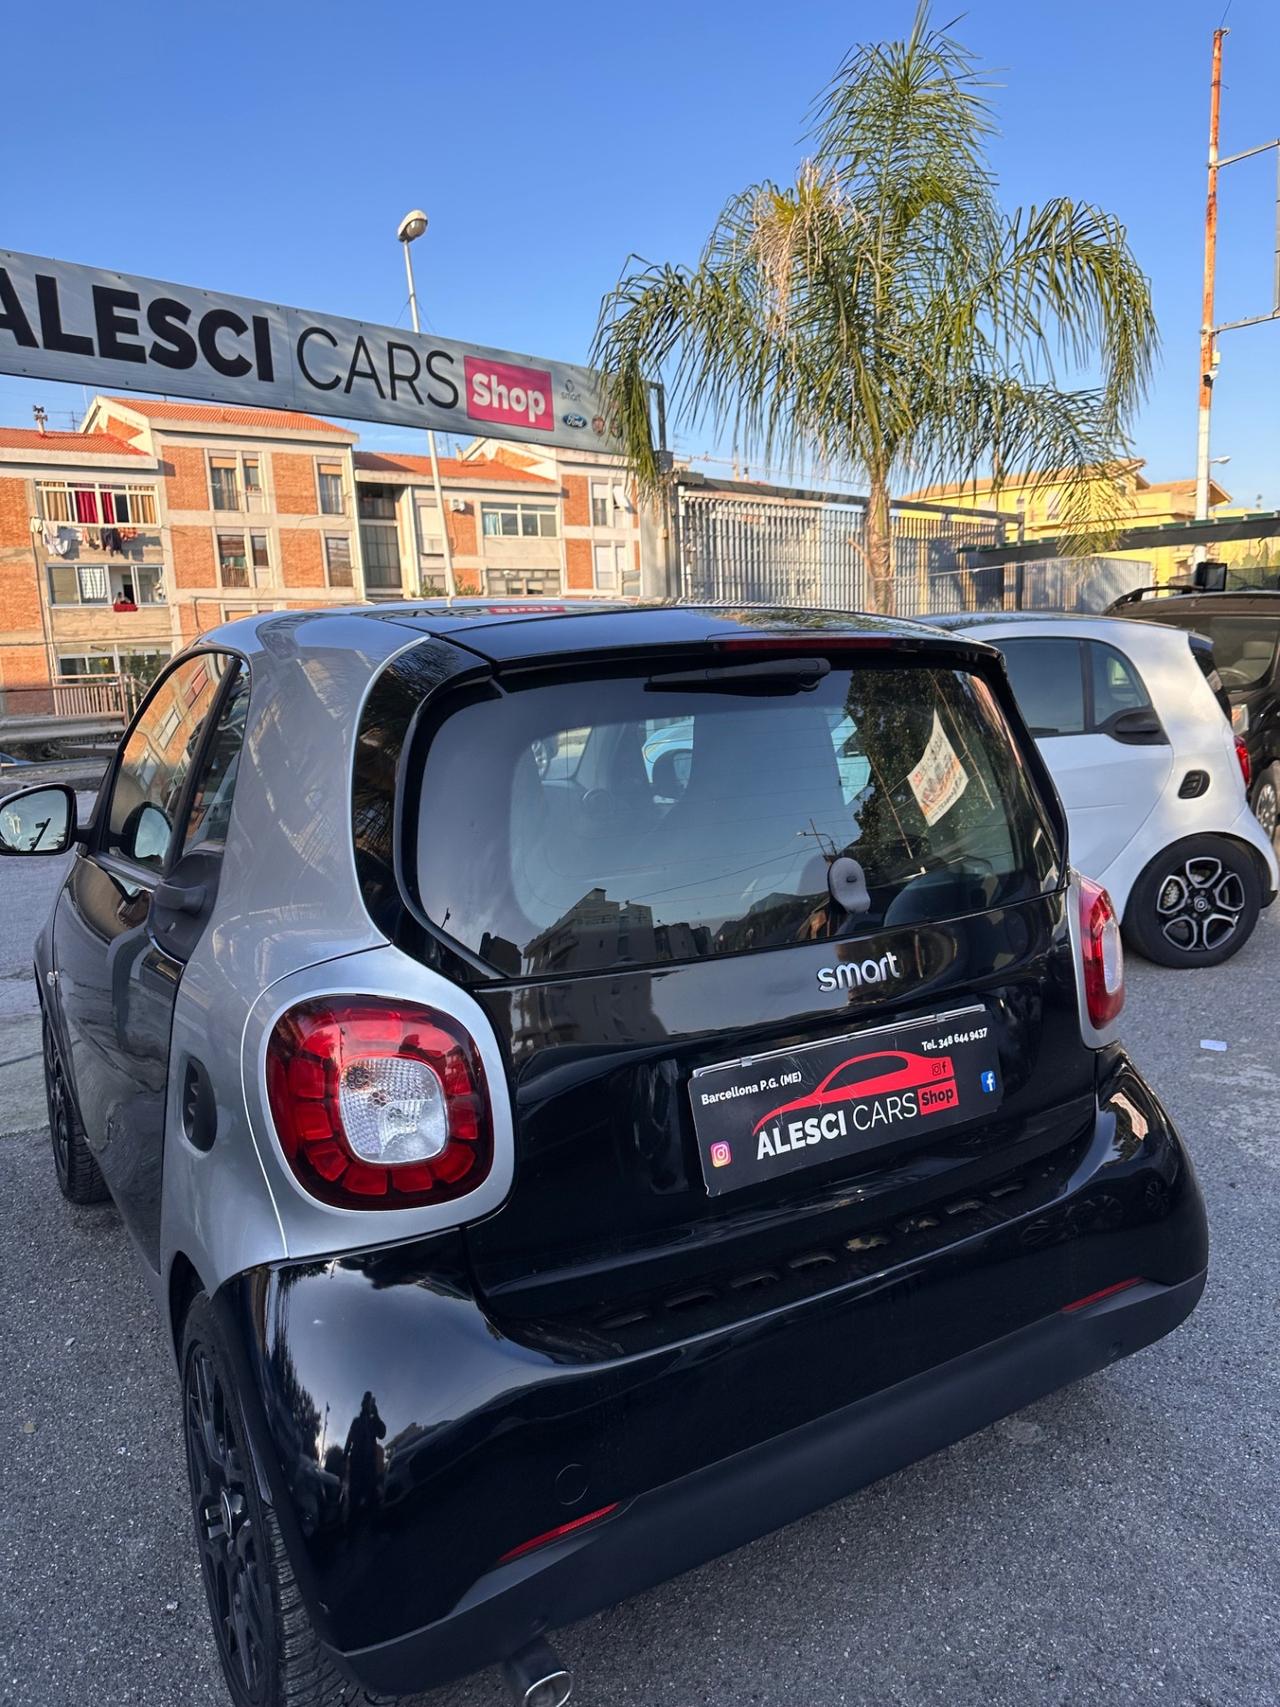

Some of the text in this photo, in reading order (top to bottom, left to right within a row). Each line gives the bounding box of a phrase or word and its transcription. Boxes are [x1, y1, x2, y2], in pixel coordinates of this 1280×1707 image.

[296, 326, 460, 410] CARS
[472, 373, 546, 424] Shop
[817, 951, 900, 992] smart
[938, 1035, 954, 1049] 348
[953, 1033, 969, 1043] 644
[969, 1027, 988, 1041] 9437
[701, 1071, 802, 1105] Barcellona P.G. (ME)
[757, 1086, 954, 1160] ALESCI CARS Shop
